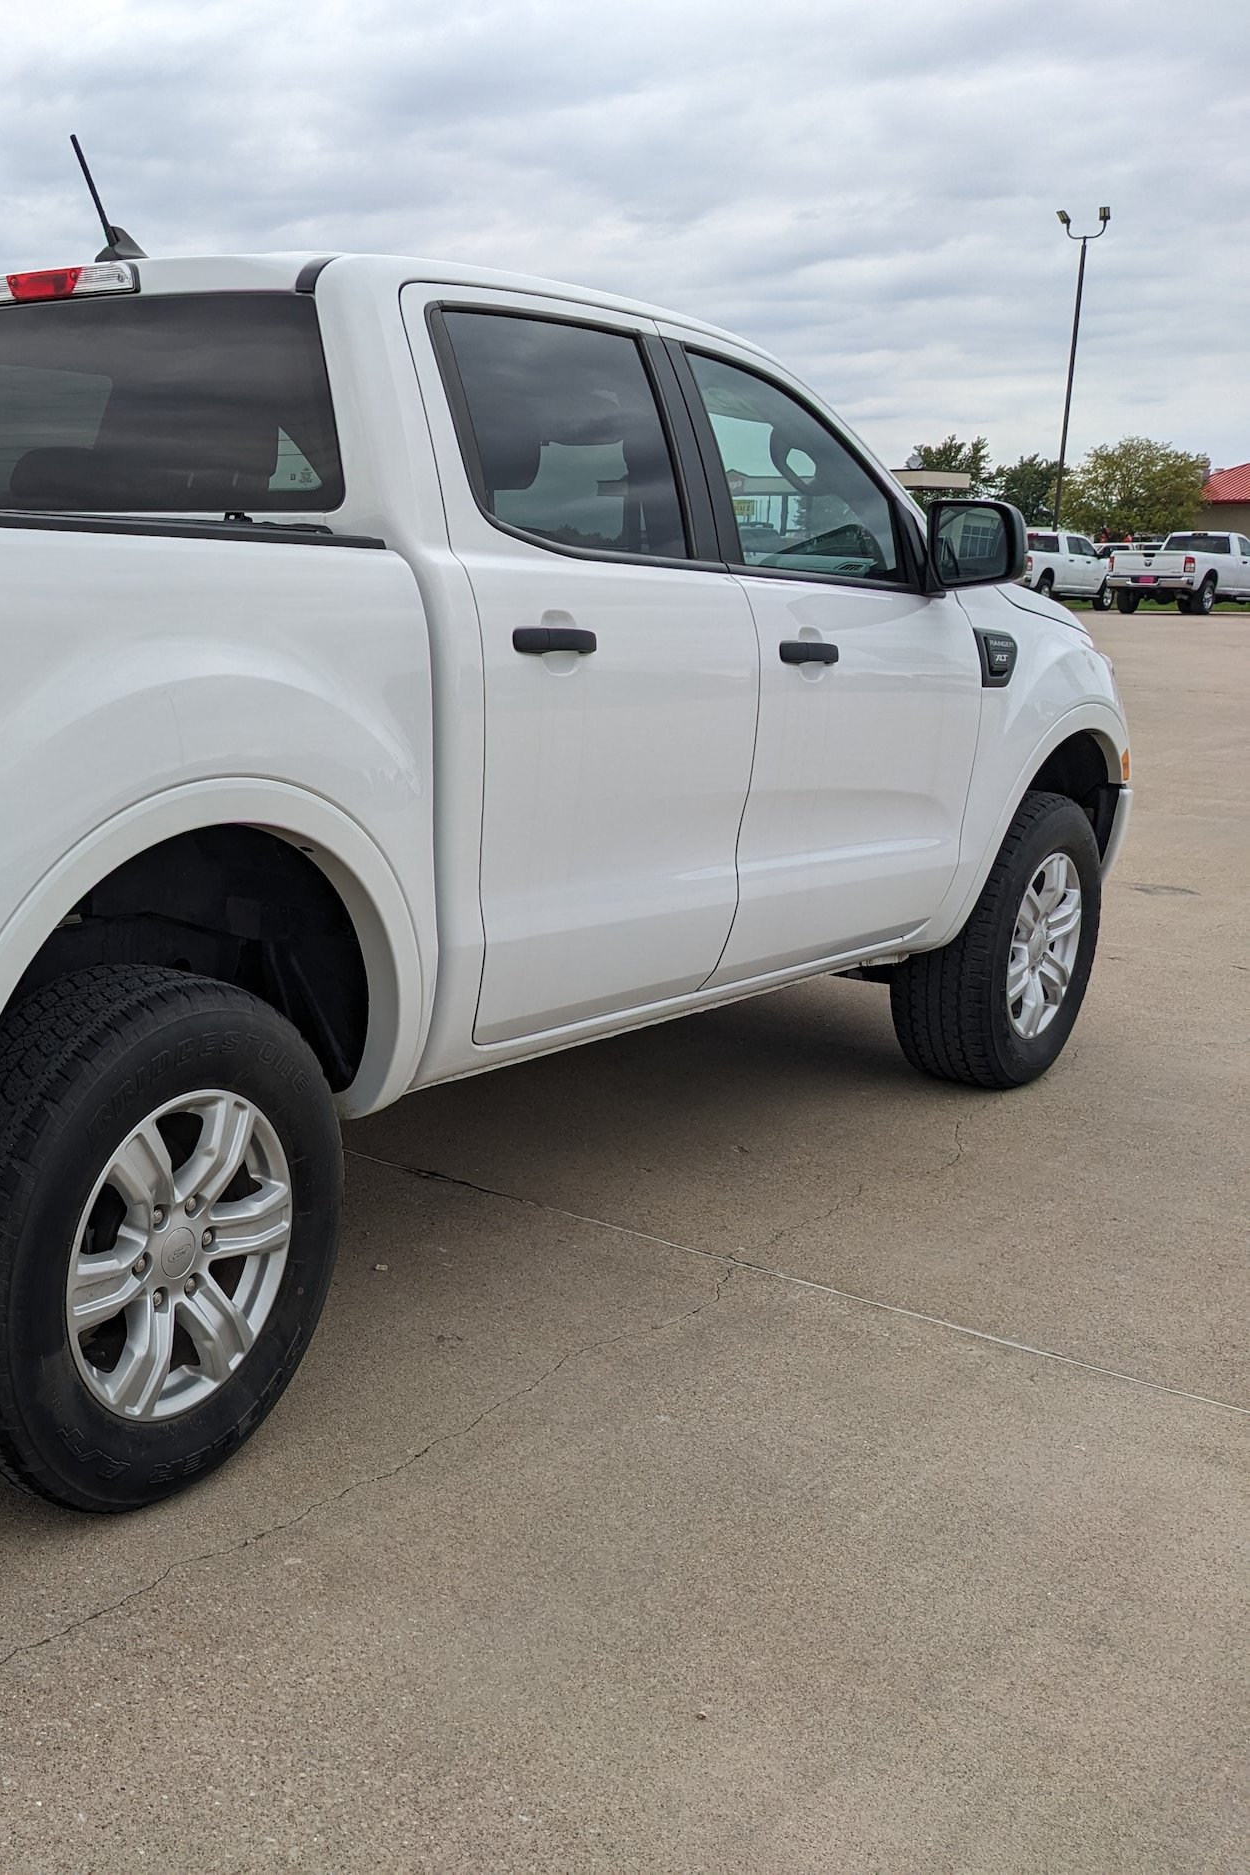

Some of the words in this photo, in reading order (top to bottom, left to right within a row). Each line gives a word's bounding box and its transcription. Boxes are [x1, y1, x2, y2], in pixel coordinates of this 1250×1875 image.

[990, 640, 1015, 648] RANGER
[994, 654, 1008, 662] XLT
[86, 1031, 311, 1148] BRIDGESTONE
